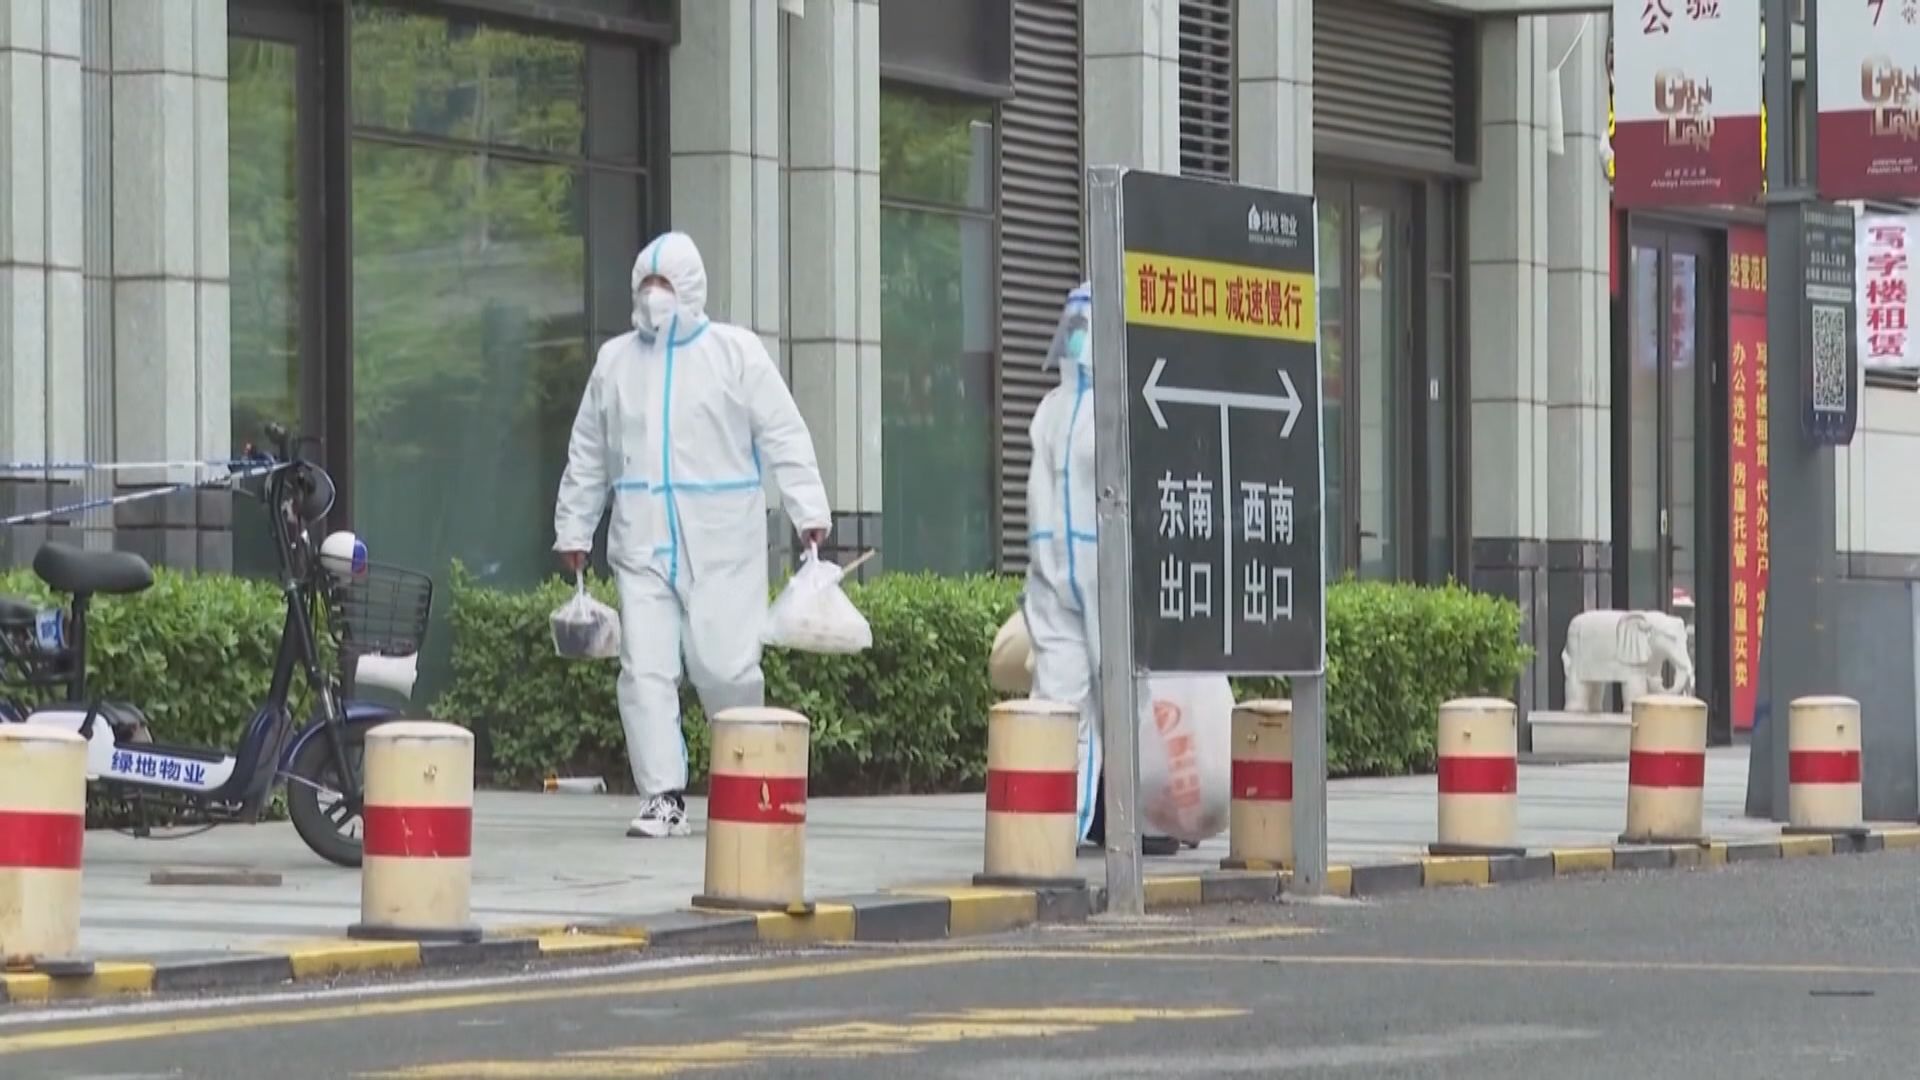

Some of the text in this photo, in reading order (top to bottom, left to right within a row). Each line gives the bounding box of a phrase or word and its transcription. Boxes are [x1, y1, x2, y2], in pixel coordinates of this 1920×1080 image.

[1138, 263, 1303, 330] 前方出口 减速慢行
[1867, 226, 1908, 357] 写字楼租赁
[1158, 470, 1214, 541] 东南
[1240, 479, 1295, 546] 西南
[1159, 553, 1212, 622] 出口
[1242, 558, 1294, 625] 出口
[111, 750, 205, 786] 绿地物业
